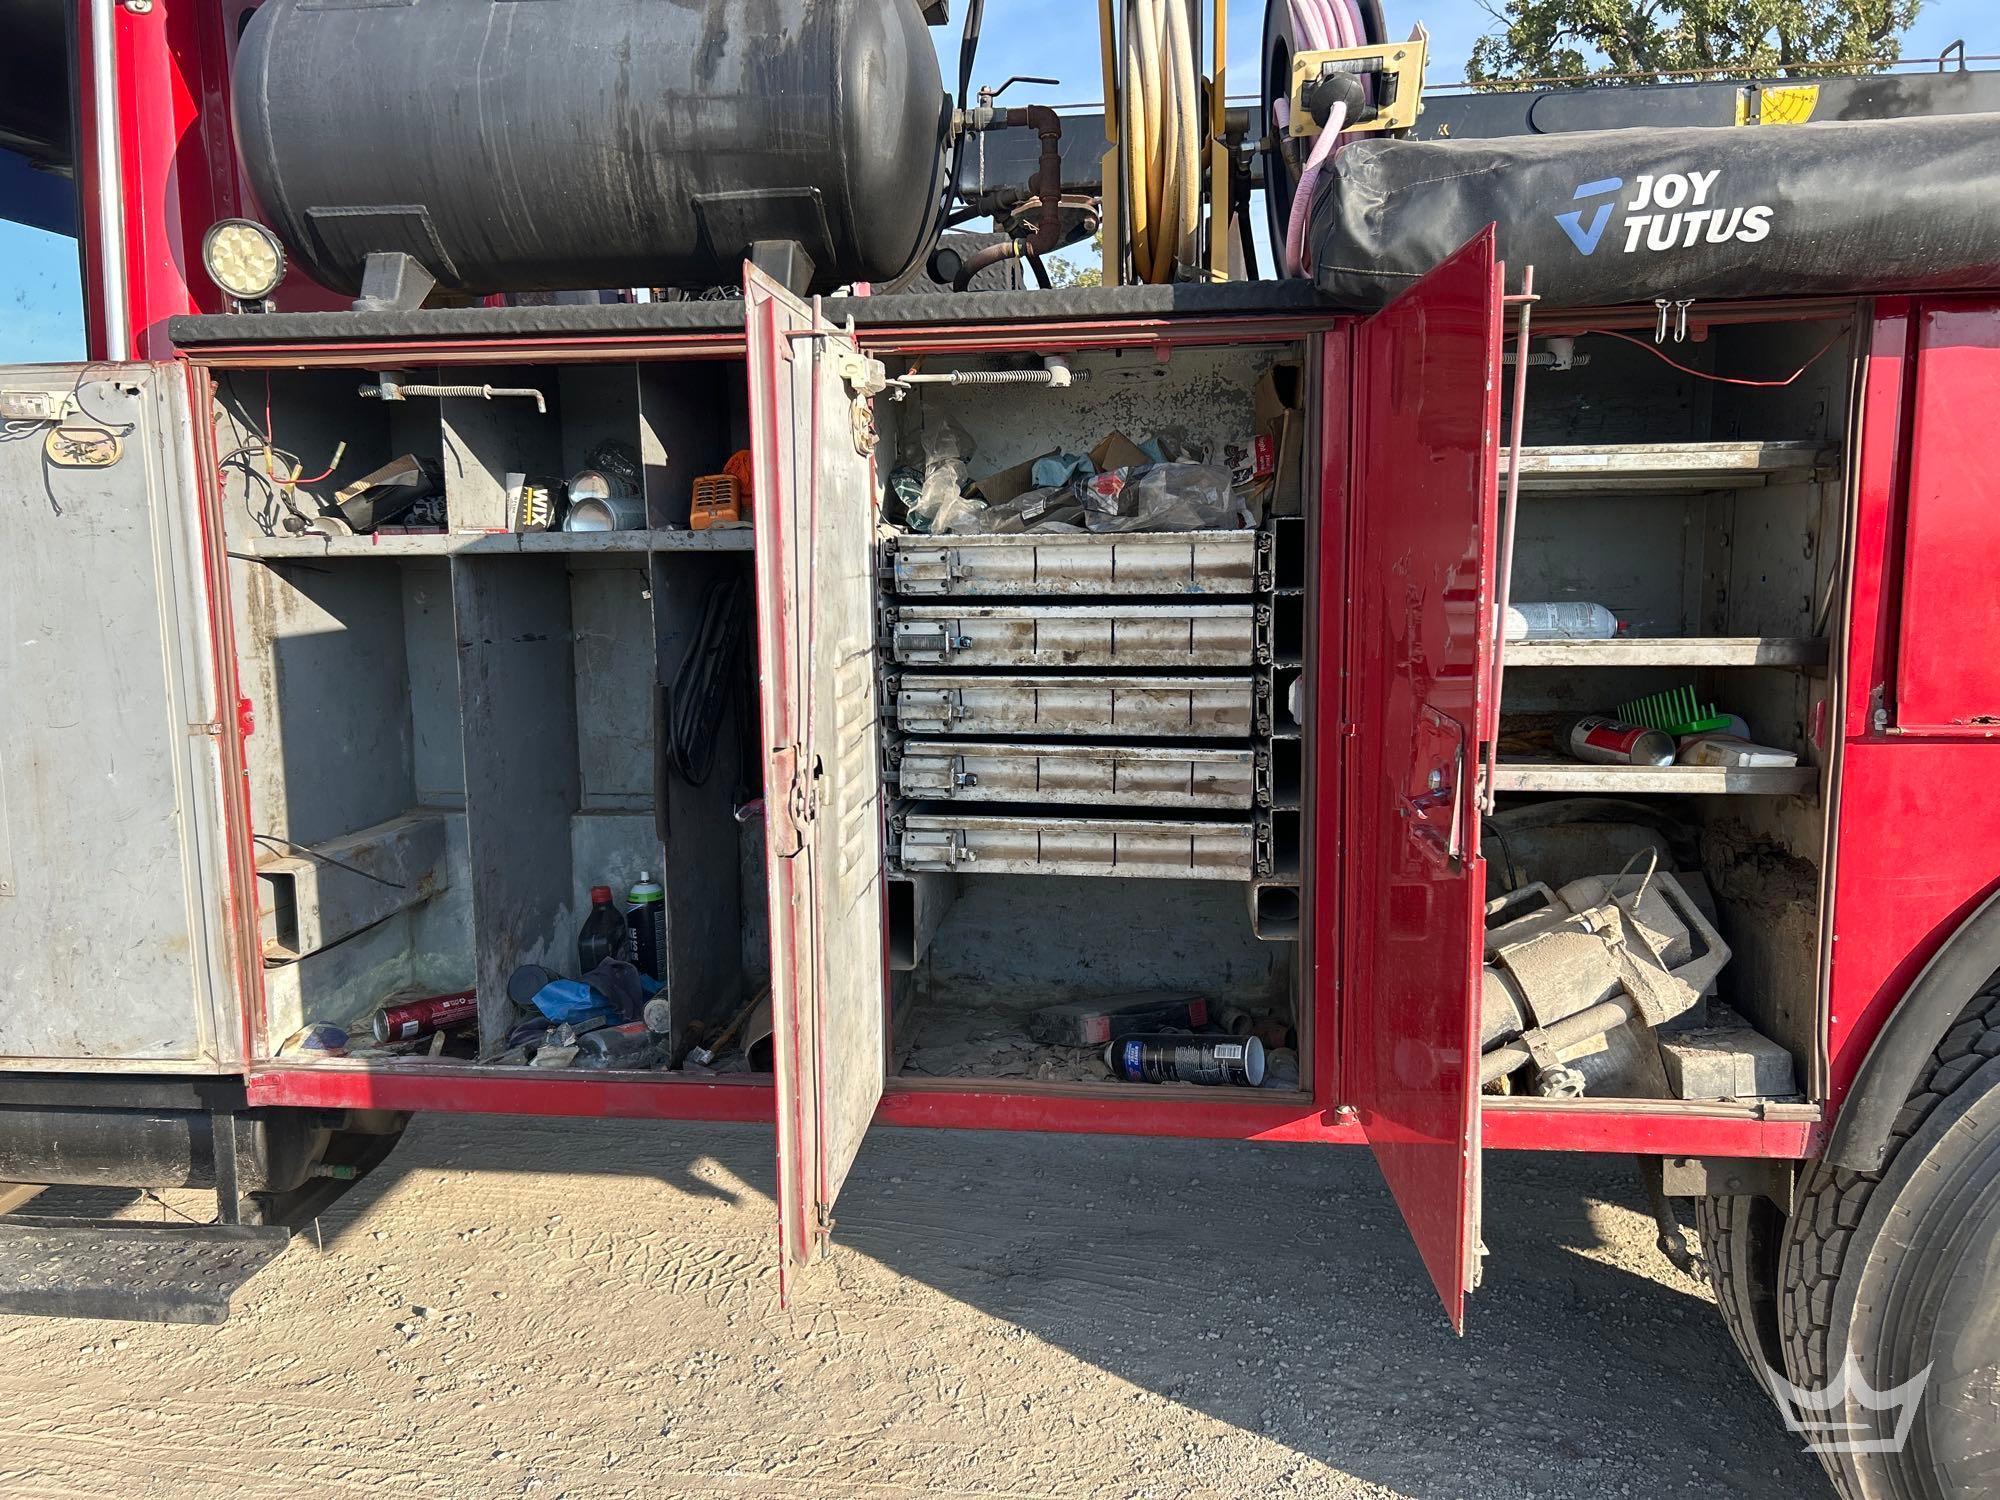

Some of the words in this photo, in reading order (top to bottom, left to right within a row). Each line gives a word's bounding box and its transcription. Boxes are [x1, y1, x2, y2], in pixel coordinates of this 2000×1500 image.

[1627, 169, 1721, 211] JOY
[1623, 205, 1774, 253] TUTUS
[531, 488, 548, 526] WIX
